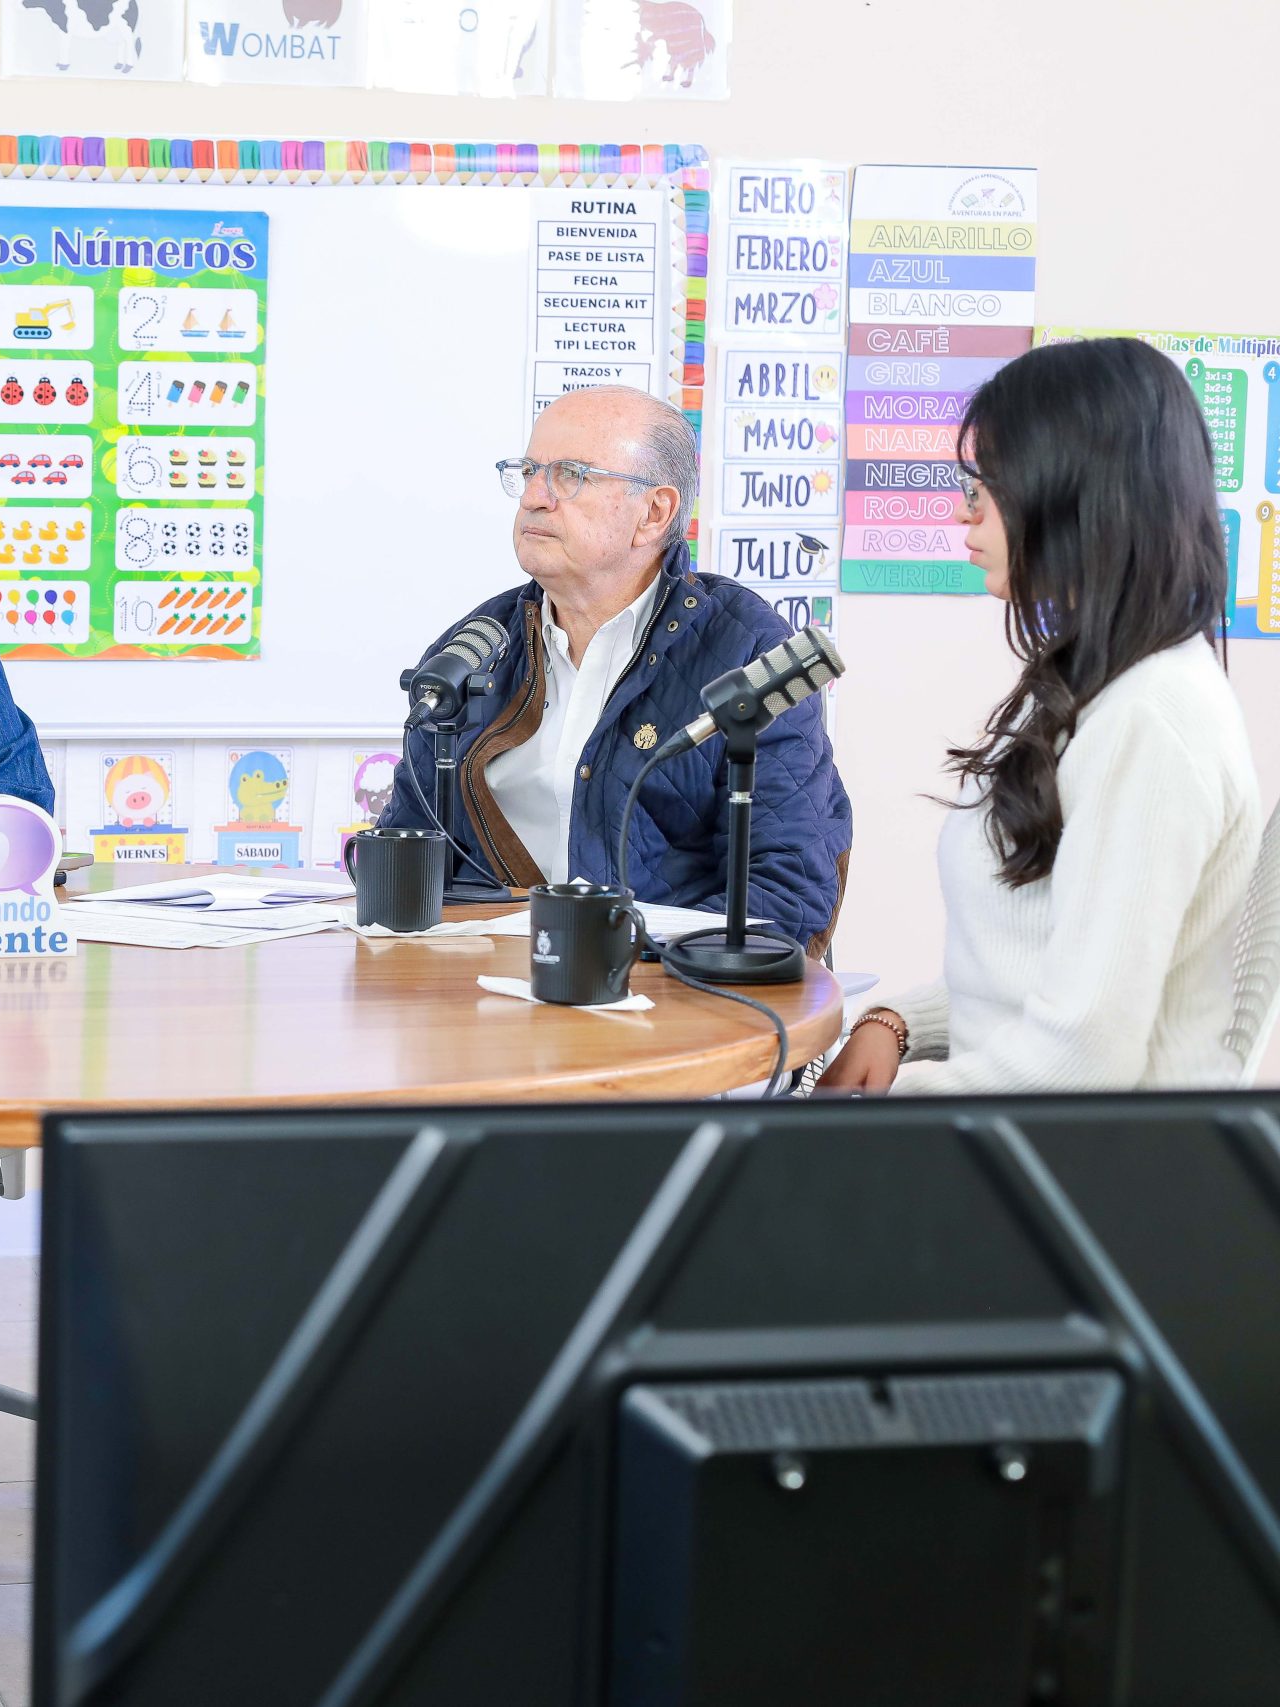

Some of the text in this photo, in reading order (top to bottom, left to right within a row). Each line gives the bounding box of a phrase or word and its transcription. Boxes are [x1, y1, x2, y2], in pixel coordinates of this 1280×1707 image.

[199, 21, 341, 61] WOMBAT
[739, 175, 816, 214] ENERO
[571, 201, 637, 215] RUTINA
[556, 227, 638, 239] BIENVENIDA
[868, 224, 1033, 251] AMARILLO
[53, 228, 257, 269] Números
[548, 251, 645, 263] PASE DE LISTA
[736, 235, 829, 272] FEBRERO
[573, 275, 618, 286] FECHA
[868, 258, 951, 284] AZUL
[544, 297, 648, 309] SECUENCIA KIT
[734, 292, 818, 325] MARZO
[868, 292, 1002, 318] BLANCO
[133, 297, 160, 340] 2
[564, 322, 626, 333] LECTURA
[554, 340, 637, 351] TIPI LECTOR
[866, 326, 950, 353] CAFÉ
[1194, 338, 1213, 352] de
[563, 367, 623, 377] TRAZOS Y
[738, 363, 820, 401] ABRIL
[865, 361, 941, 386] GRIS
[1190, 363, 1200, 377] 3
[1204, 371, 1233, 381] 3x1=3
[1267, 366, 1277, 380] 4
[129, 372, 156, 417] 4
[1203, 383, 1233, 393] 3x2=6
[1203, 395, 1232, 405] 3x3=9
[1203, 407, 1237, 417] 3x4=12
[743, 418, 814, 452] MAYO
[128, 446, 156, 486] 6
[740, 471, 811, 508] JUNIO
[863, 496, 954, 520] ROJO
[1261, 505, 1270, 520] 9
[124, 517, 153, 563] 8
[862, 529, 952, 553] ROSA
[732, 538, 814, 580] JULIO
[859, 564, 964, 588] VERDE
[106, 757, 114, 767] 5
[115, 848, 166, 860] VIERNES
[236, 845, 280, 859] SÁBADO
